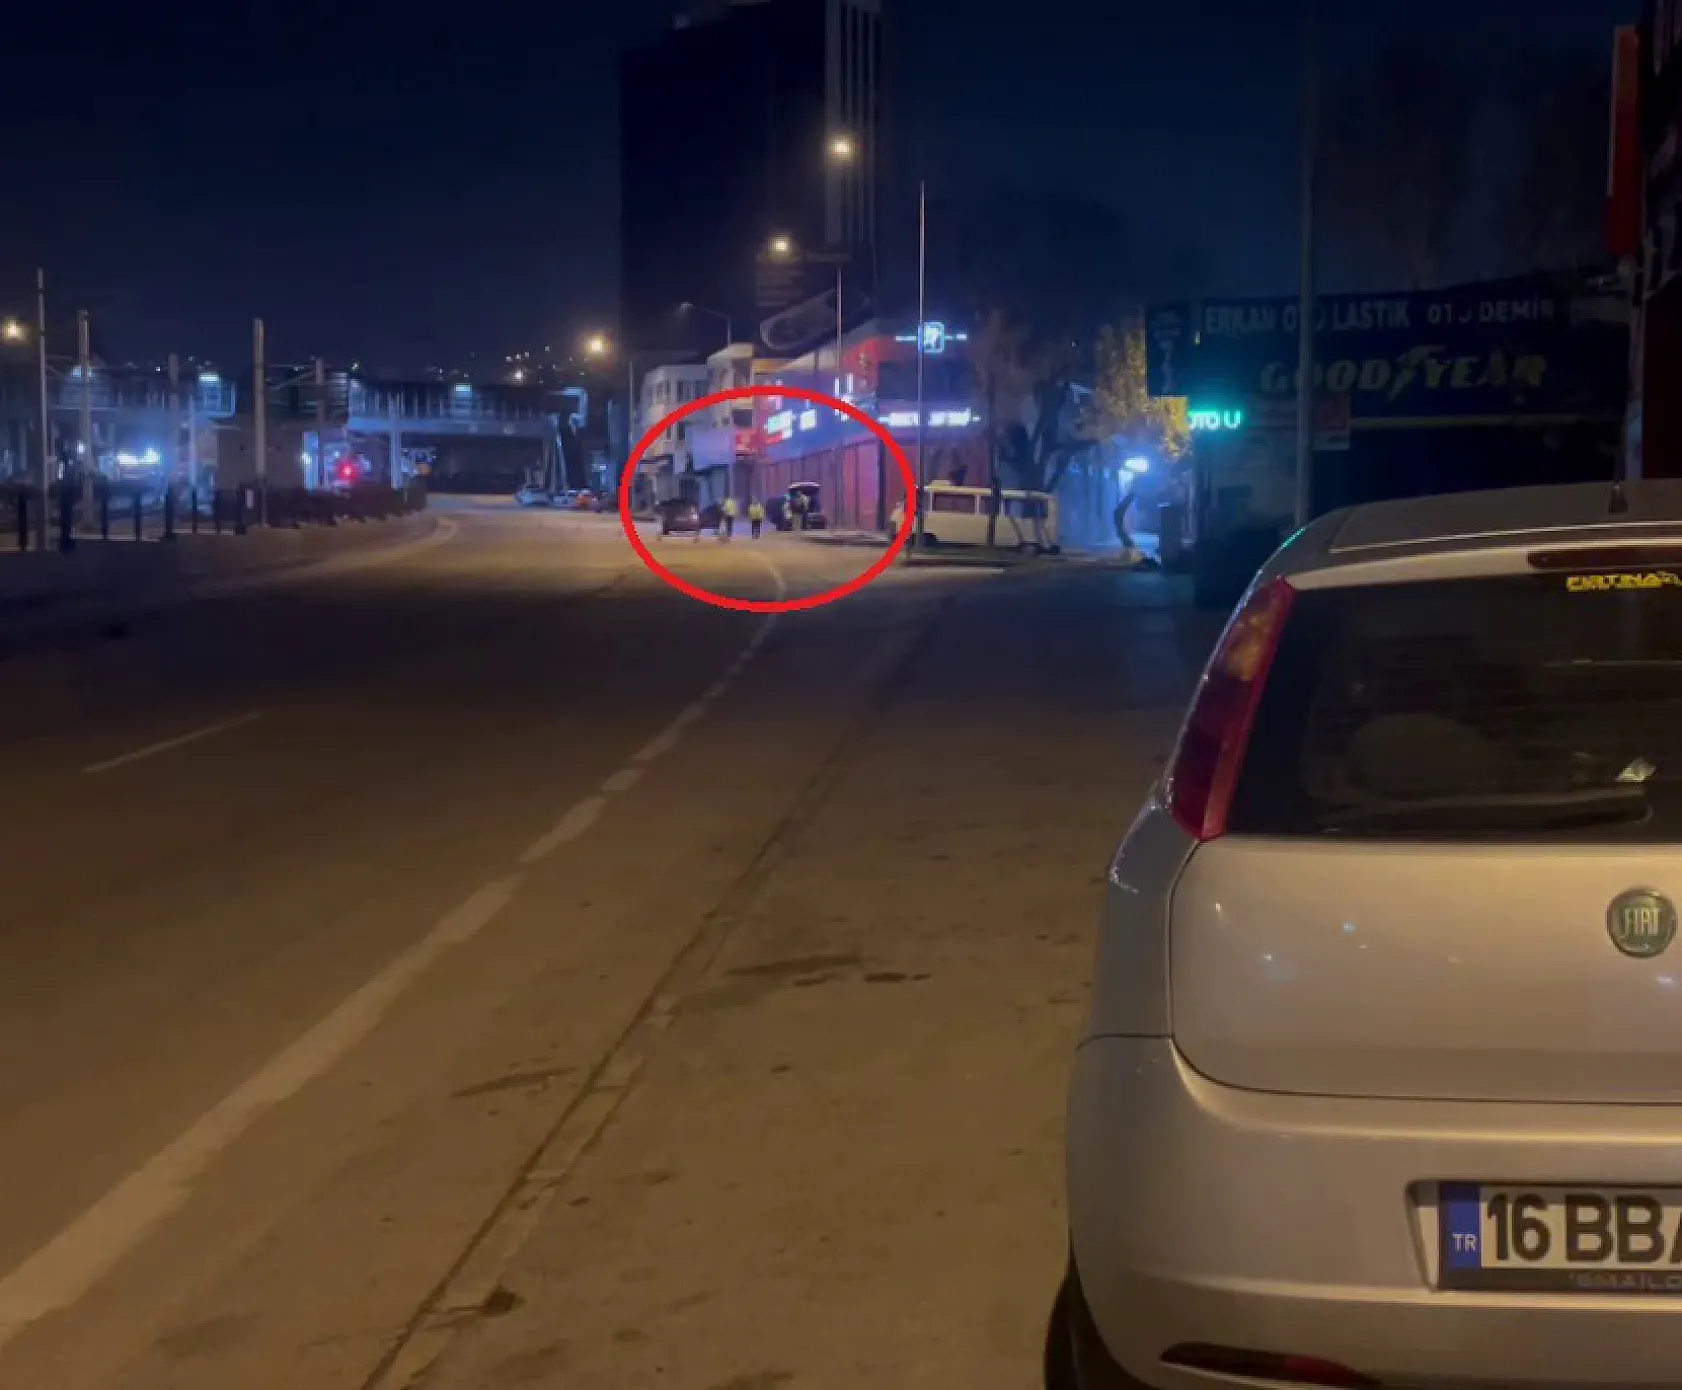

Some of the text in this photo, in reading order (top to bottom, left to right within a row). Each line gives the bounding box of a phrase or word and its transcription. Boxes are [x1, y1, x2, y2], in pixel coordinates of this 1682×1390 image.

[1281, 300, 1326, 331] OO
[1623, 908, 1661, 935] FIAT
[1452, 1232, 1478, 1252] TR
[1486, 1193, 1682, 1264] 16 BB
